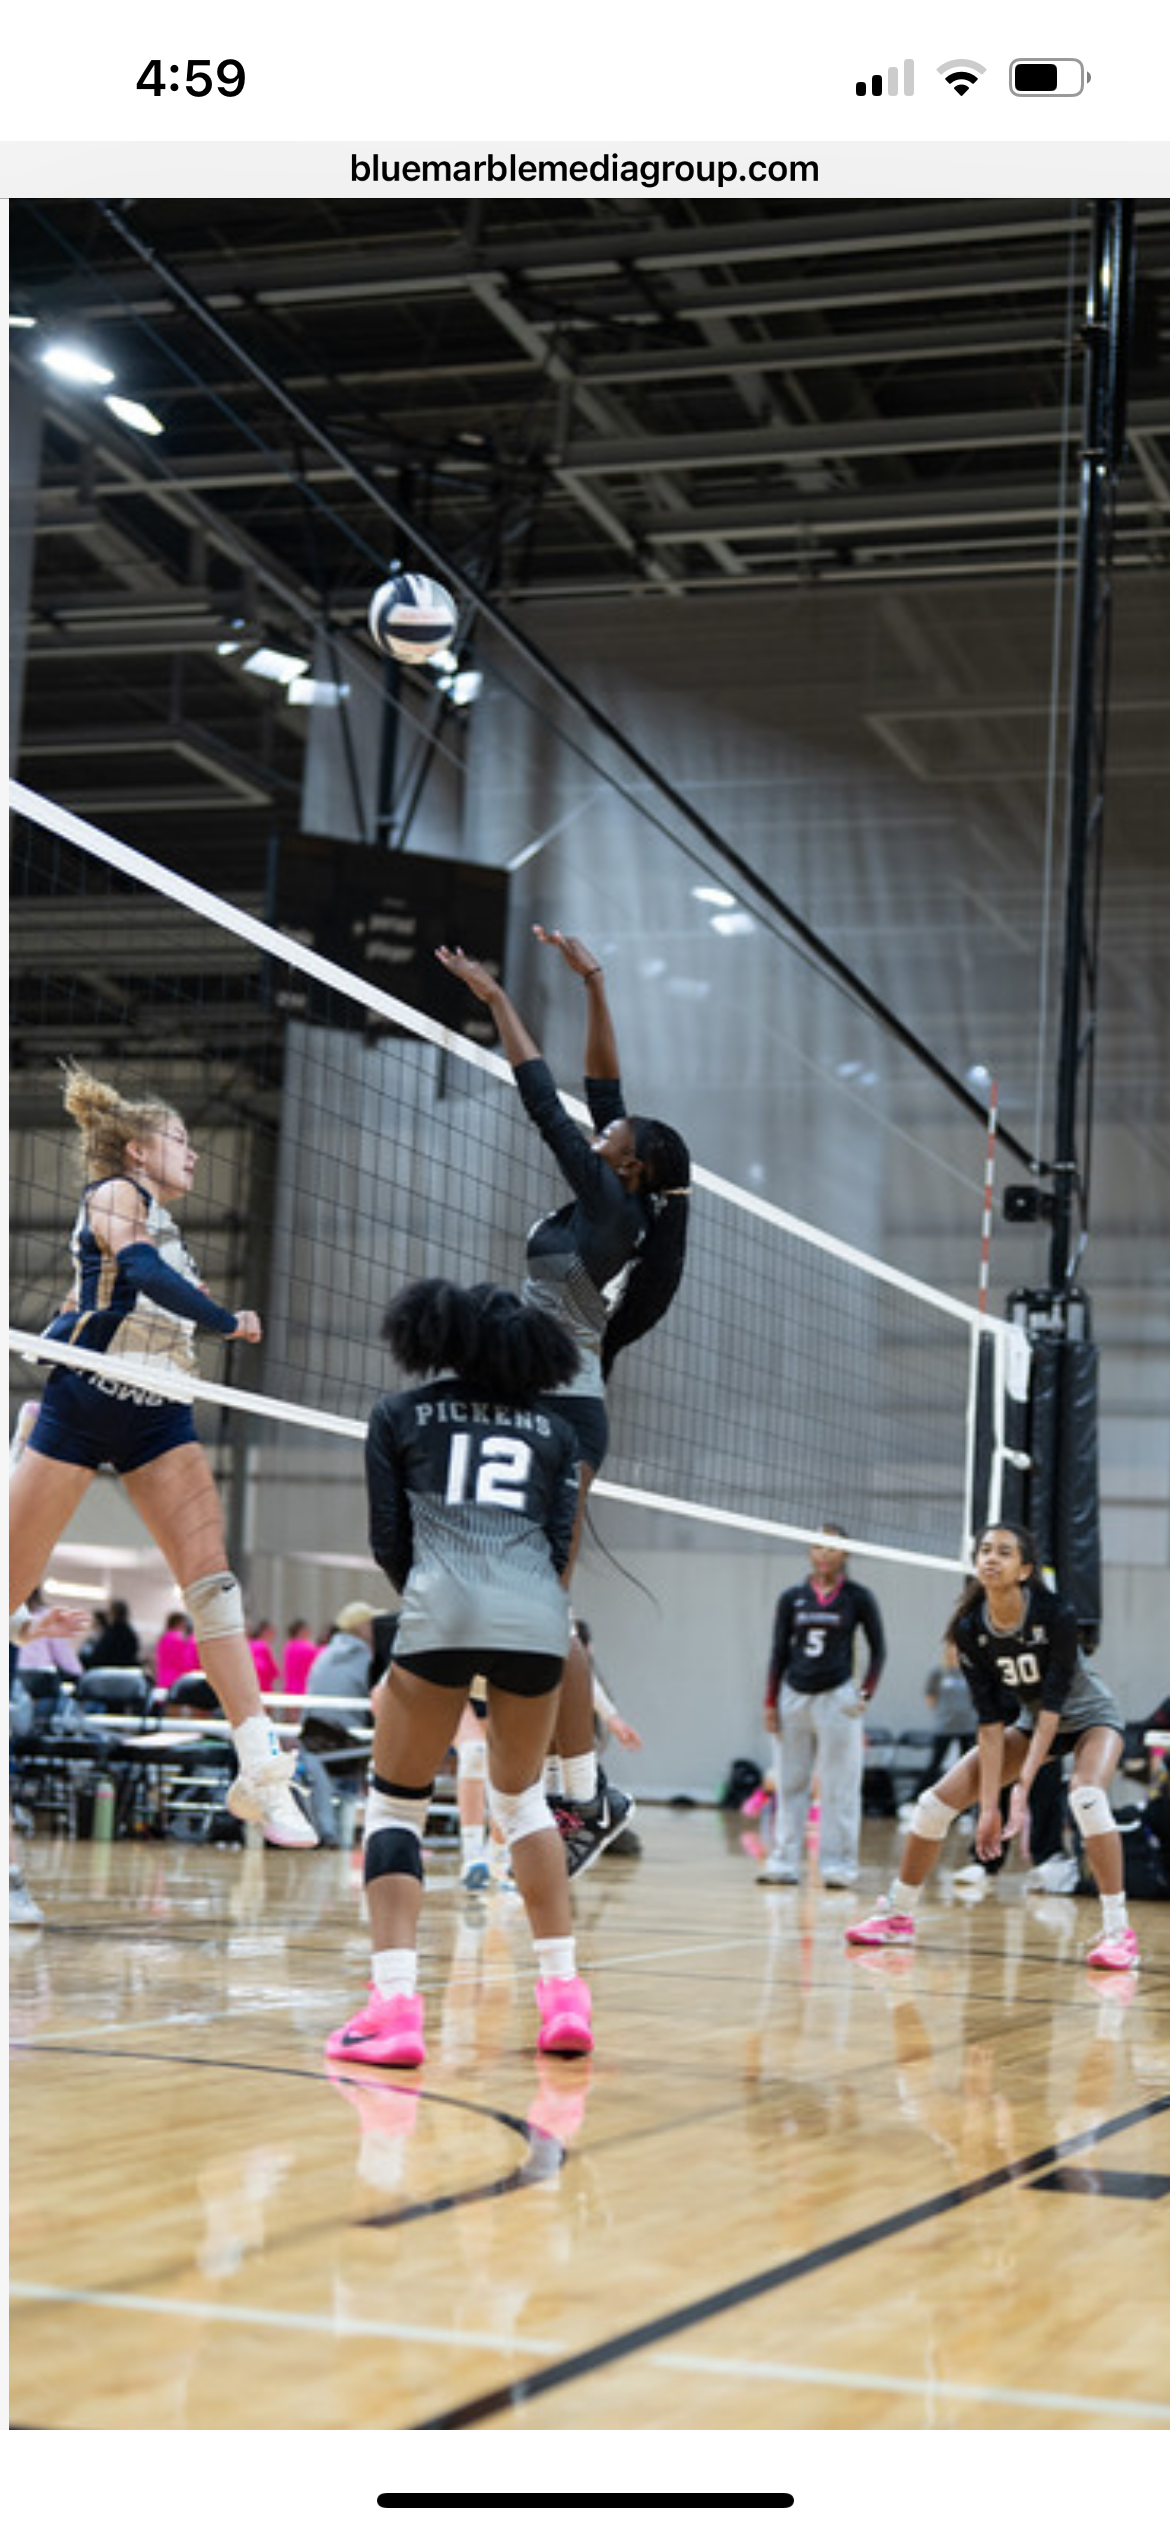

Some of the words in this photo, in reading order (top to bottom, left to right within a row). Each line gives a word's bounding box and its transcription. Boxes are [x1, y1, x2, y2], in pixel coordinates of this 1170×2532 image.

[415, 1401, 552, 1438] PICKENS
[447, 1433, 531, 1510] 12
[804, 1628, 827, 1658] 5
[996, 1654, 1040, 1686] 30
